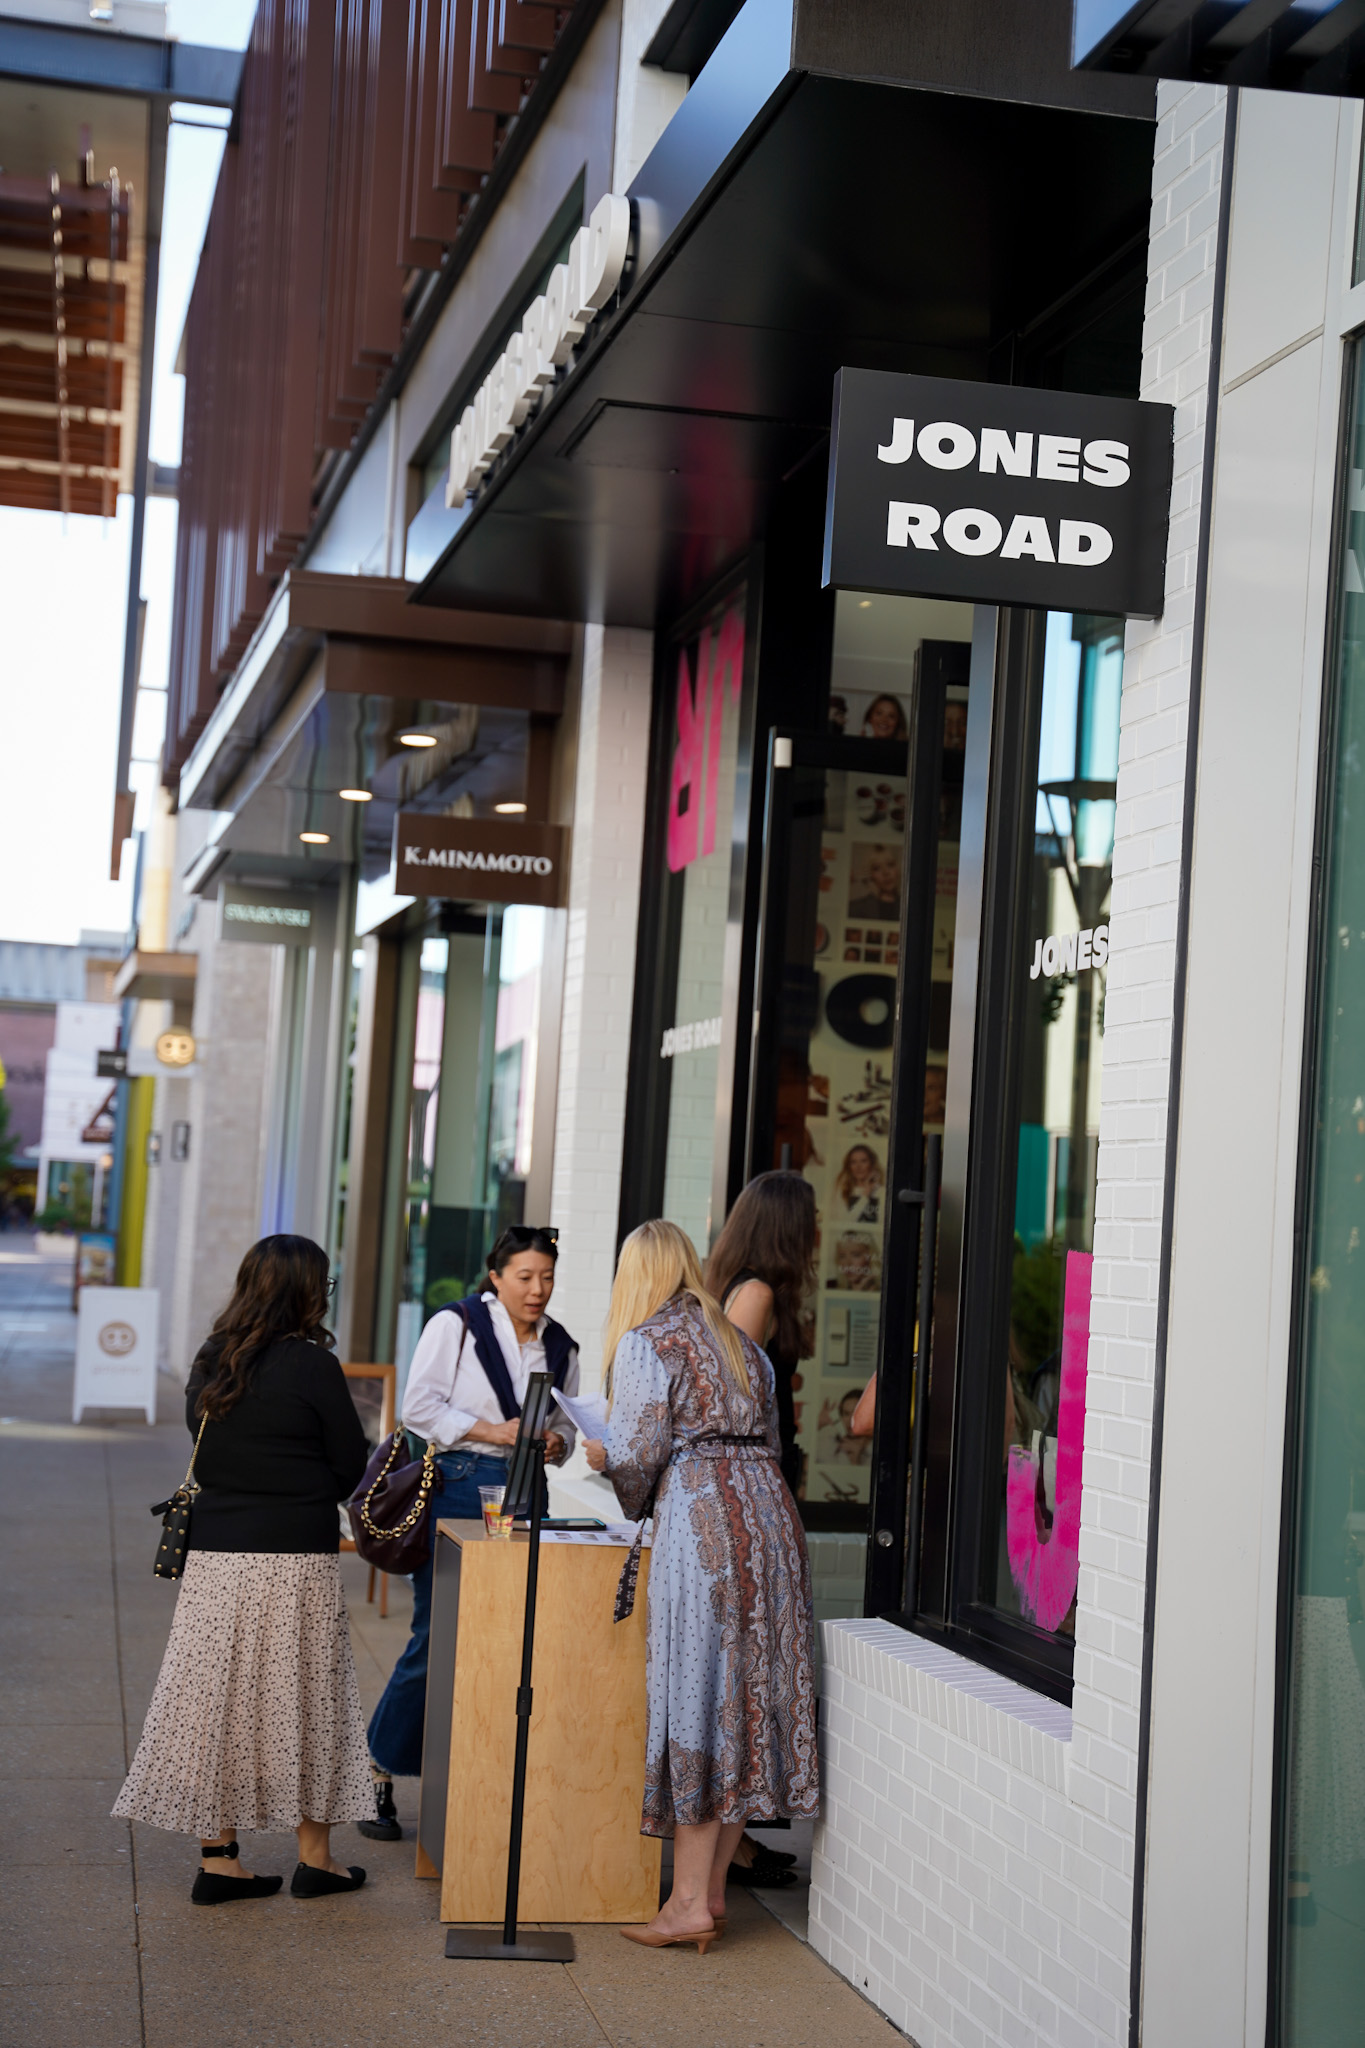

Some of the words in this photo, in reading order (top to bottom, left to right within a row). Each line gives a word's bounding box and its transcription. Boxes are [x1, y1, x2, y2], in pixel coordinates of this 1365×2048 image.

[877, 418, 1131, 488] JONES
[886, 501, 1114, 567] ROAD
[404, 846, 553, 876] K.MINAMOTO
[1029, 924, 1109, 981] JONES
